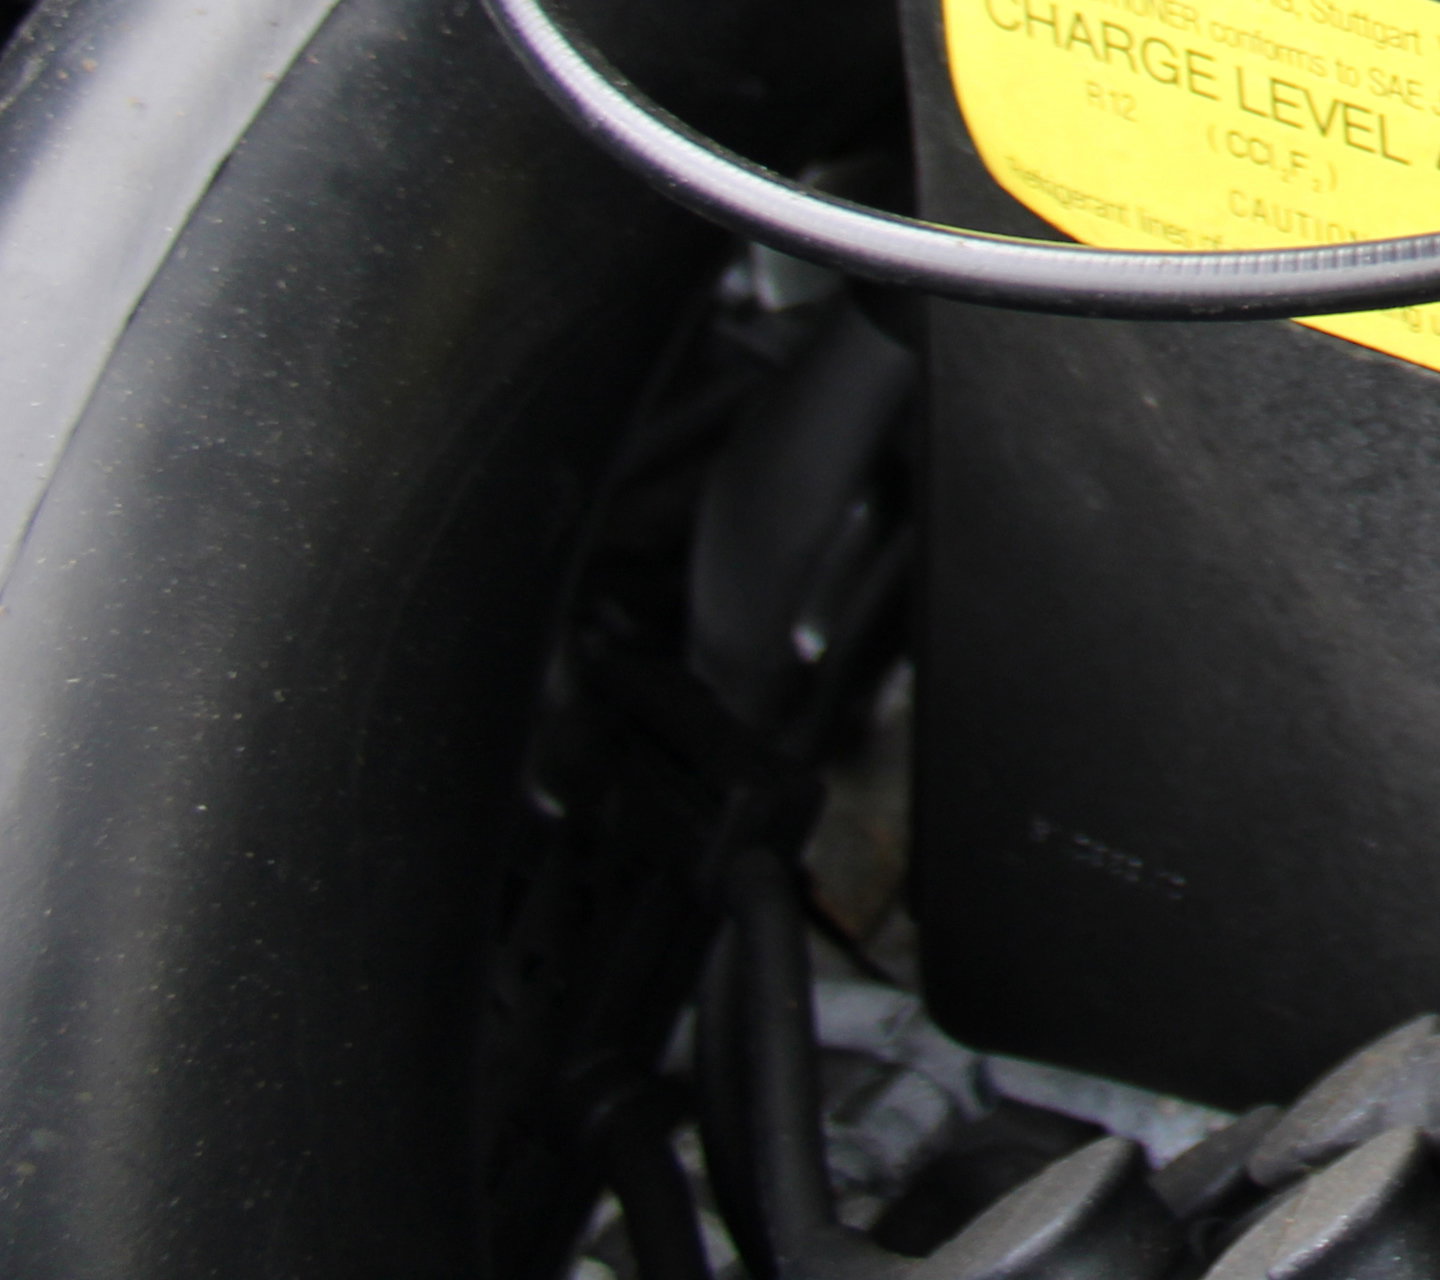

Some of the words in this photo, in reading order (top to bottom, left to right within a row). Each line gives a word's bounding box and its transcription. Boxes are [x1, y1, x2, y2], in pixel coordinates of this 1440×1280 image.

[1210, 21, 1326, 77] conforms
[1334, 58, 1360, 88] to
[1368, 68, 1425, 111] SAE
[1236, 65, 1412, 166] LEVEL
